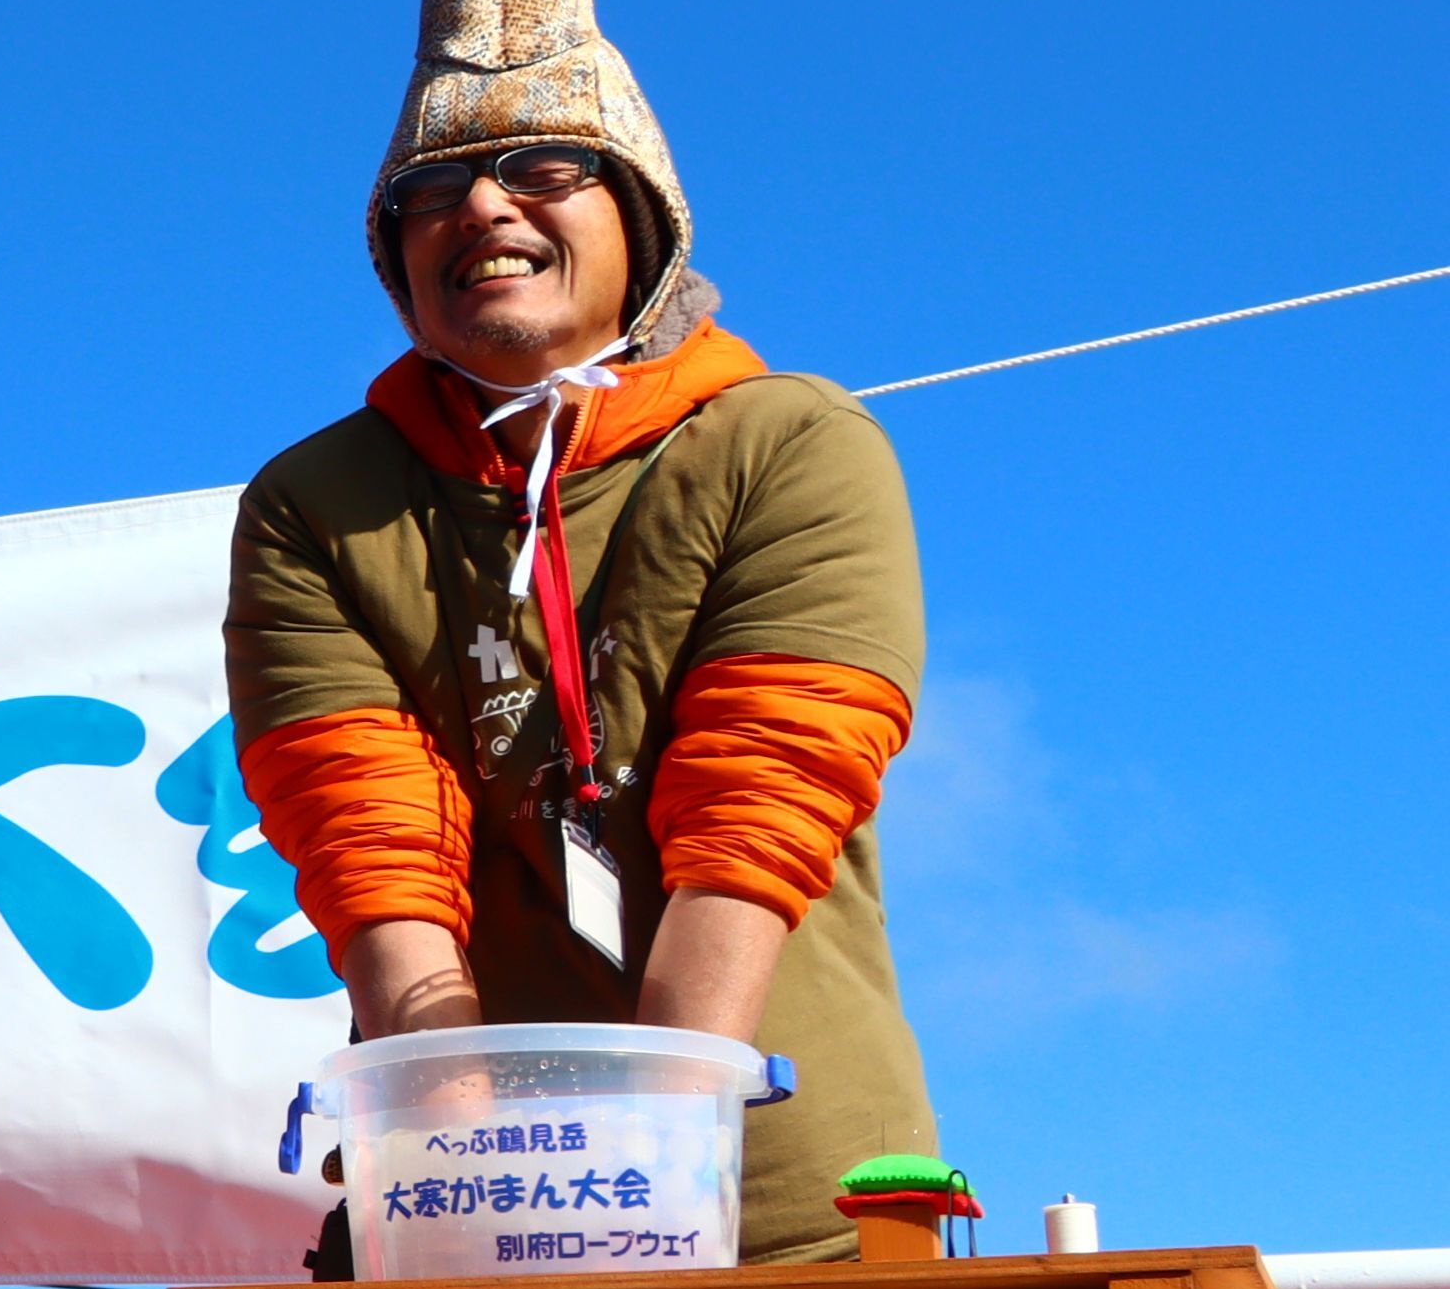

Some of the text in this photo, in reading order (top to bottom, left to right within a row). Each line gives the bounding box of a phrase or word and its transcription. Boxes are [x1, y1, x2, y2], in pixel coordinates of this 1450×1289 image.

[425, 1121, 588, 1156] べっぷ鶴見岳
[383, 1167, 651, 1222] 大寒がまん大会
[496, 1229, 701, 1262] 別府ロープウェイ
